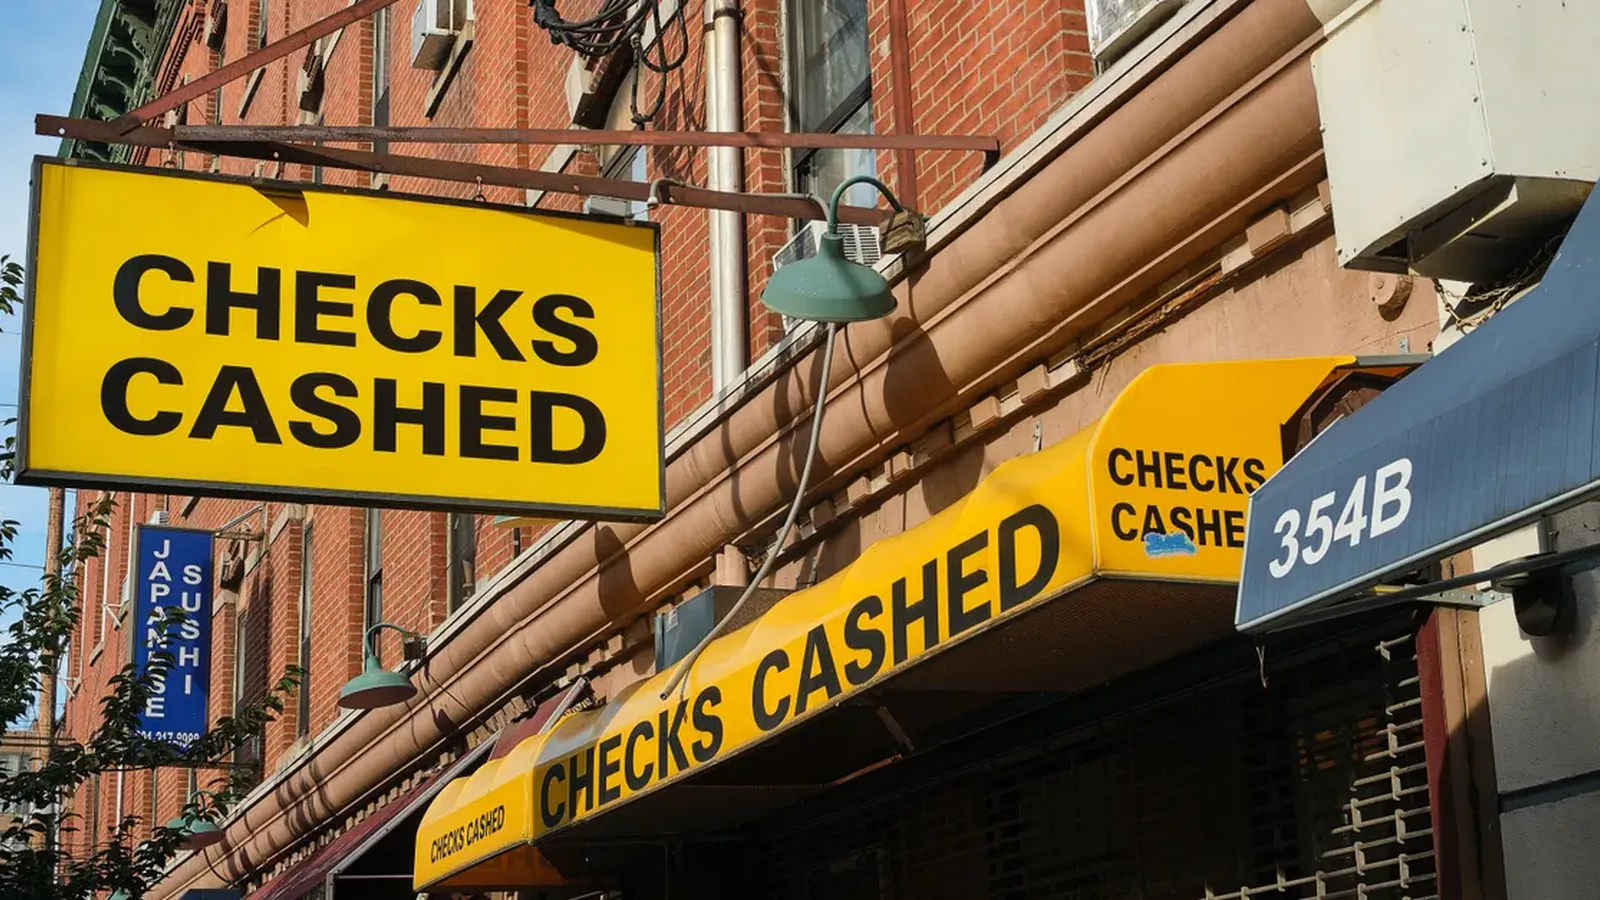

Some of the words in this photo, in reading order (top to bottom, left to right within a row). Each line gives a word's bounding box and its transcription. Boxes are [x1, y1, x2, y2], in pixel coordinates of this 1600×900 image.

[112, 254, 599, 366] CHECKS
[100, 357, 607, 465] CASHED
[1108, 447, 1267, 495] CHECKS
[1111, 502, 1245, 548] CASHE
[1269, 457, 1413, 579] 354B
[145, 539, 172, 718] JAPANESE
[179, 564, 203, 695] SUSHI
[540, 685, 724, 829] CHECKS
[752, 503, 1060, 732] CASHED
[431, 826, 465, 863] CHECKS
[466, 805, 505, 846] CASHED
